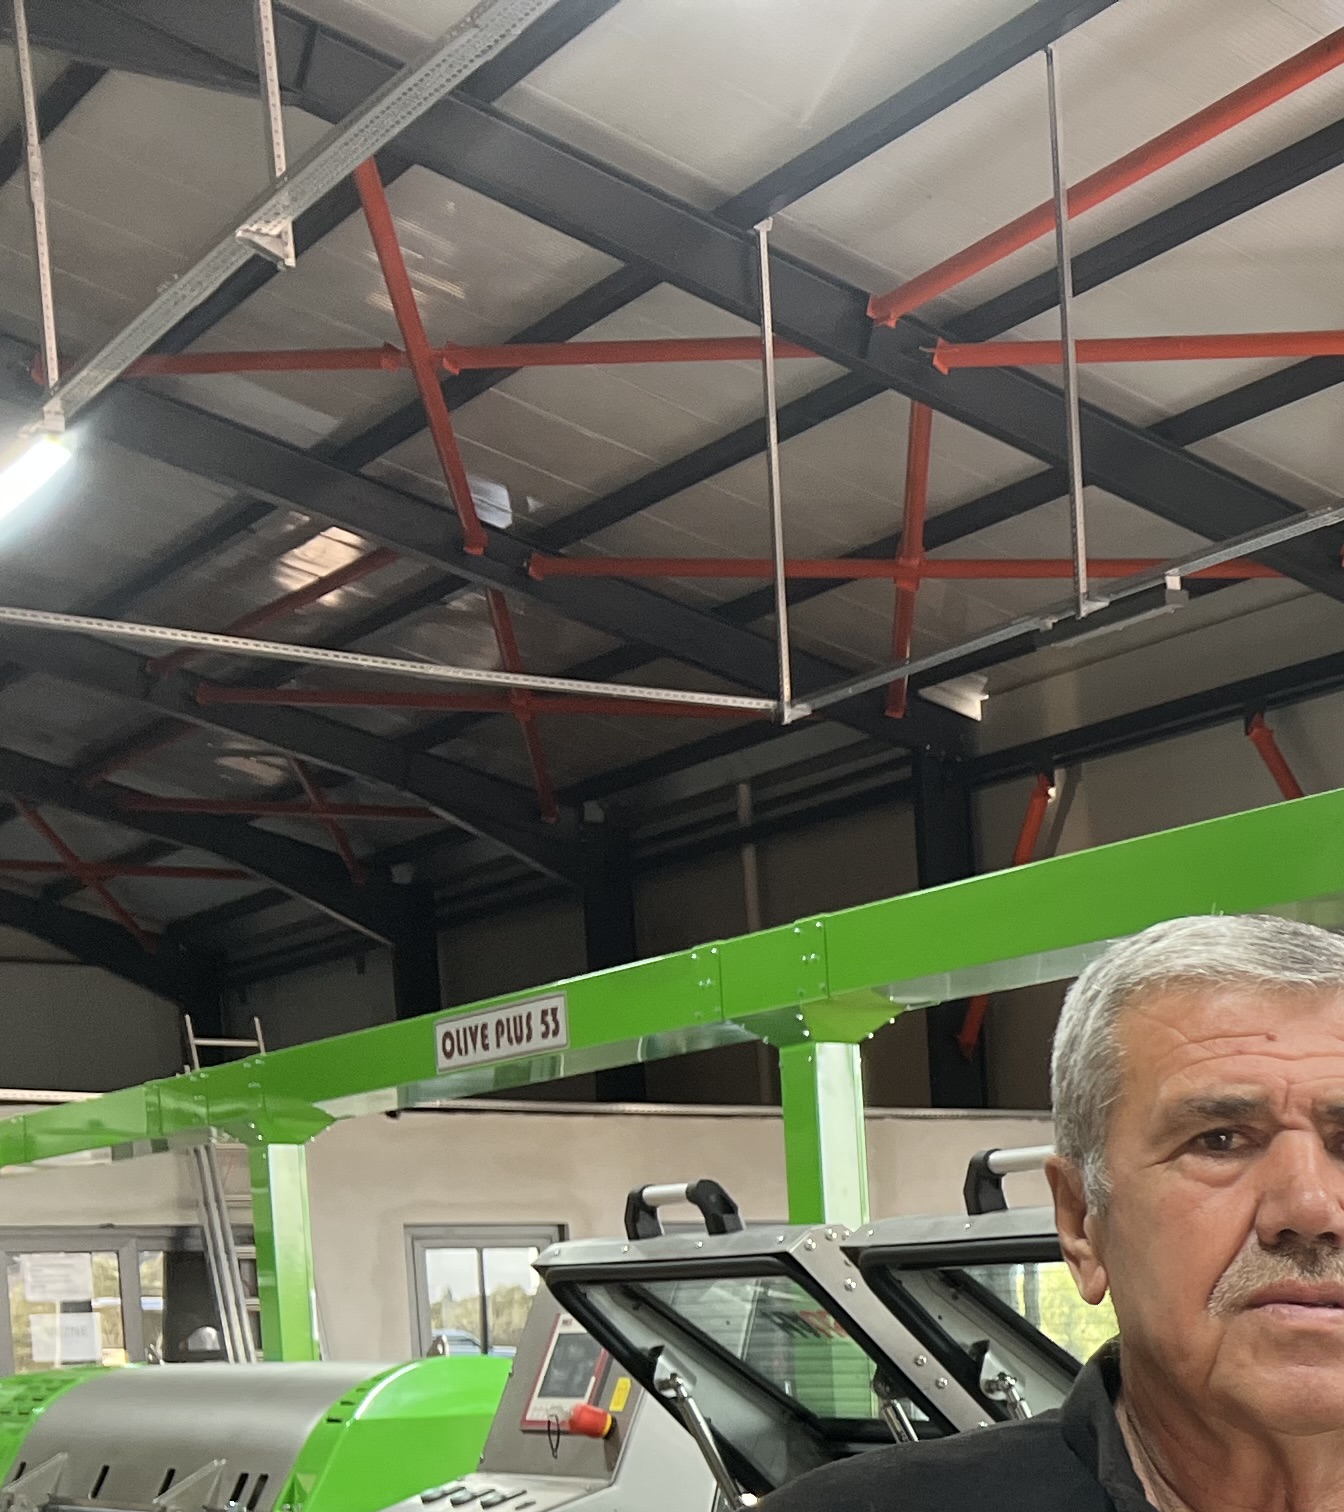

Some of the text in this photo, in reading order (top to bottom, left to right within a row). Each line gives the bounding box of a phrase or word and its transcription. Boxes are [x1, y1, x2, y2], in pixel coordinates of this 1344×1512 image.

[442, 1006, 560, 1060] OLIVE PLUS 53
